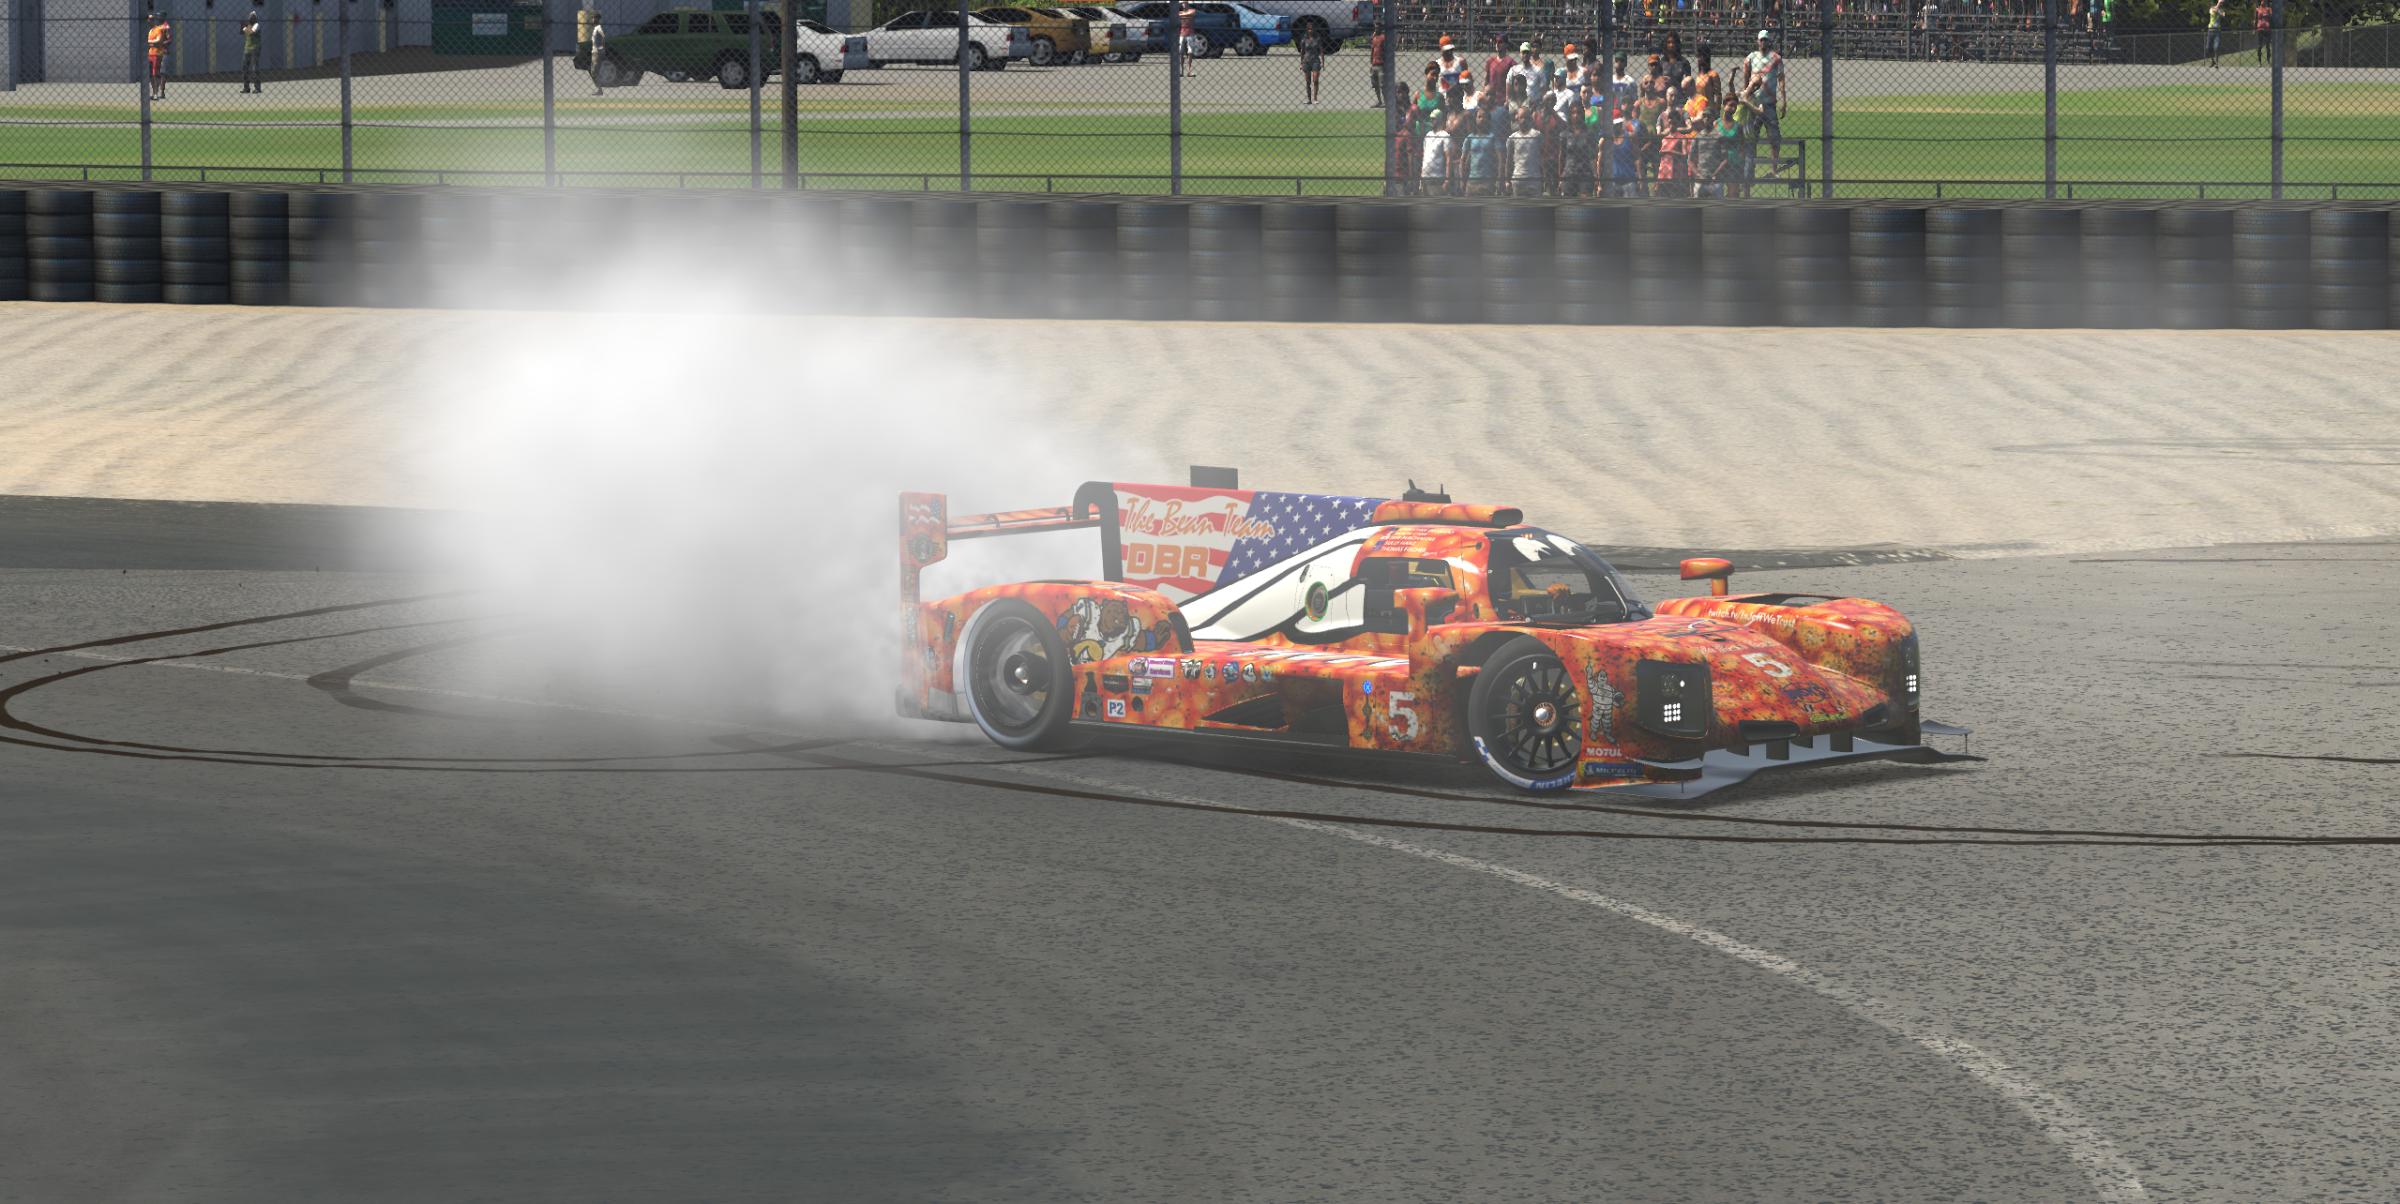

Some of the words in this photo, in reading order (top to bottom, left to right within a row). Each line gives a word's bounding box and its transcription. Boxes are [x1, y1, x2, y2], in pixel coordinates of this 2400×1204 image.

[1124, 497, 1155, 534] The
[1158, 498, 1215, 537] Bean
[1222, 502, 1275, 538] Team
[1127, 543, 1209, 577] DBR
[1741, 652, 1793, 678] 5
[1108, 701, 1124, 715] P2
[1388, 690, 1418, 741] 5
[1586, 747, 1623, 757] MOTUL
